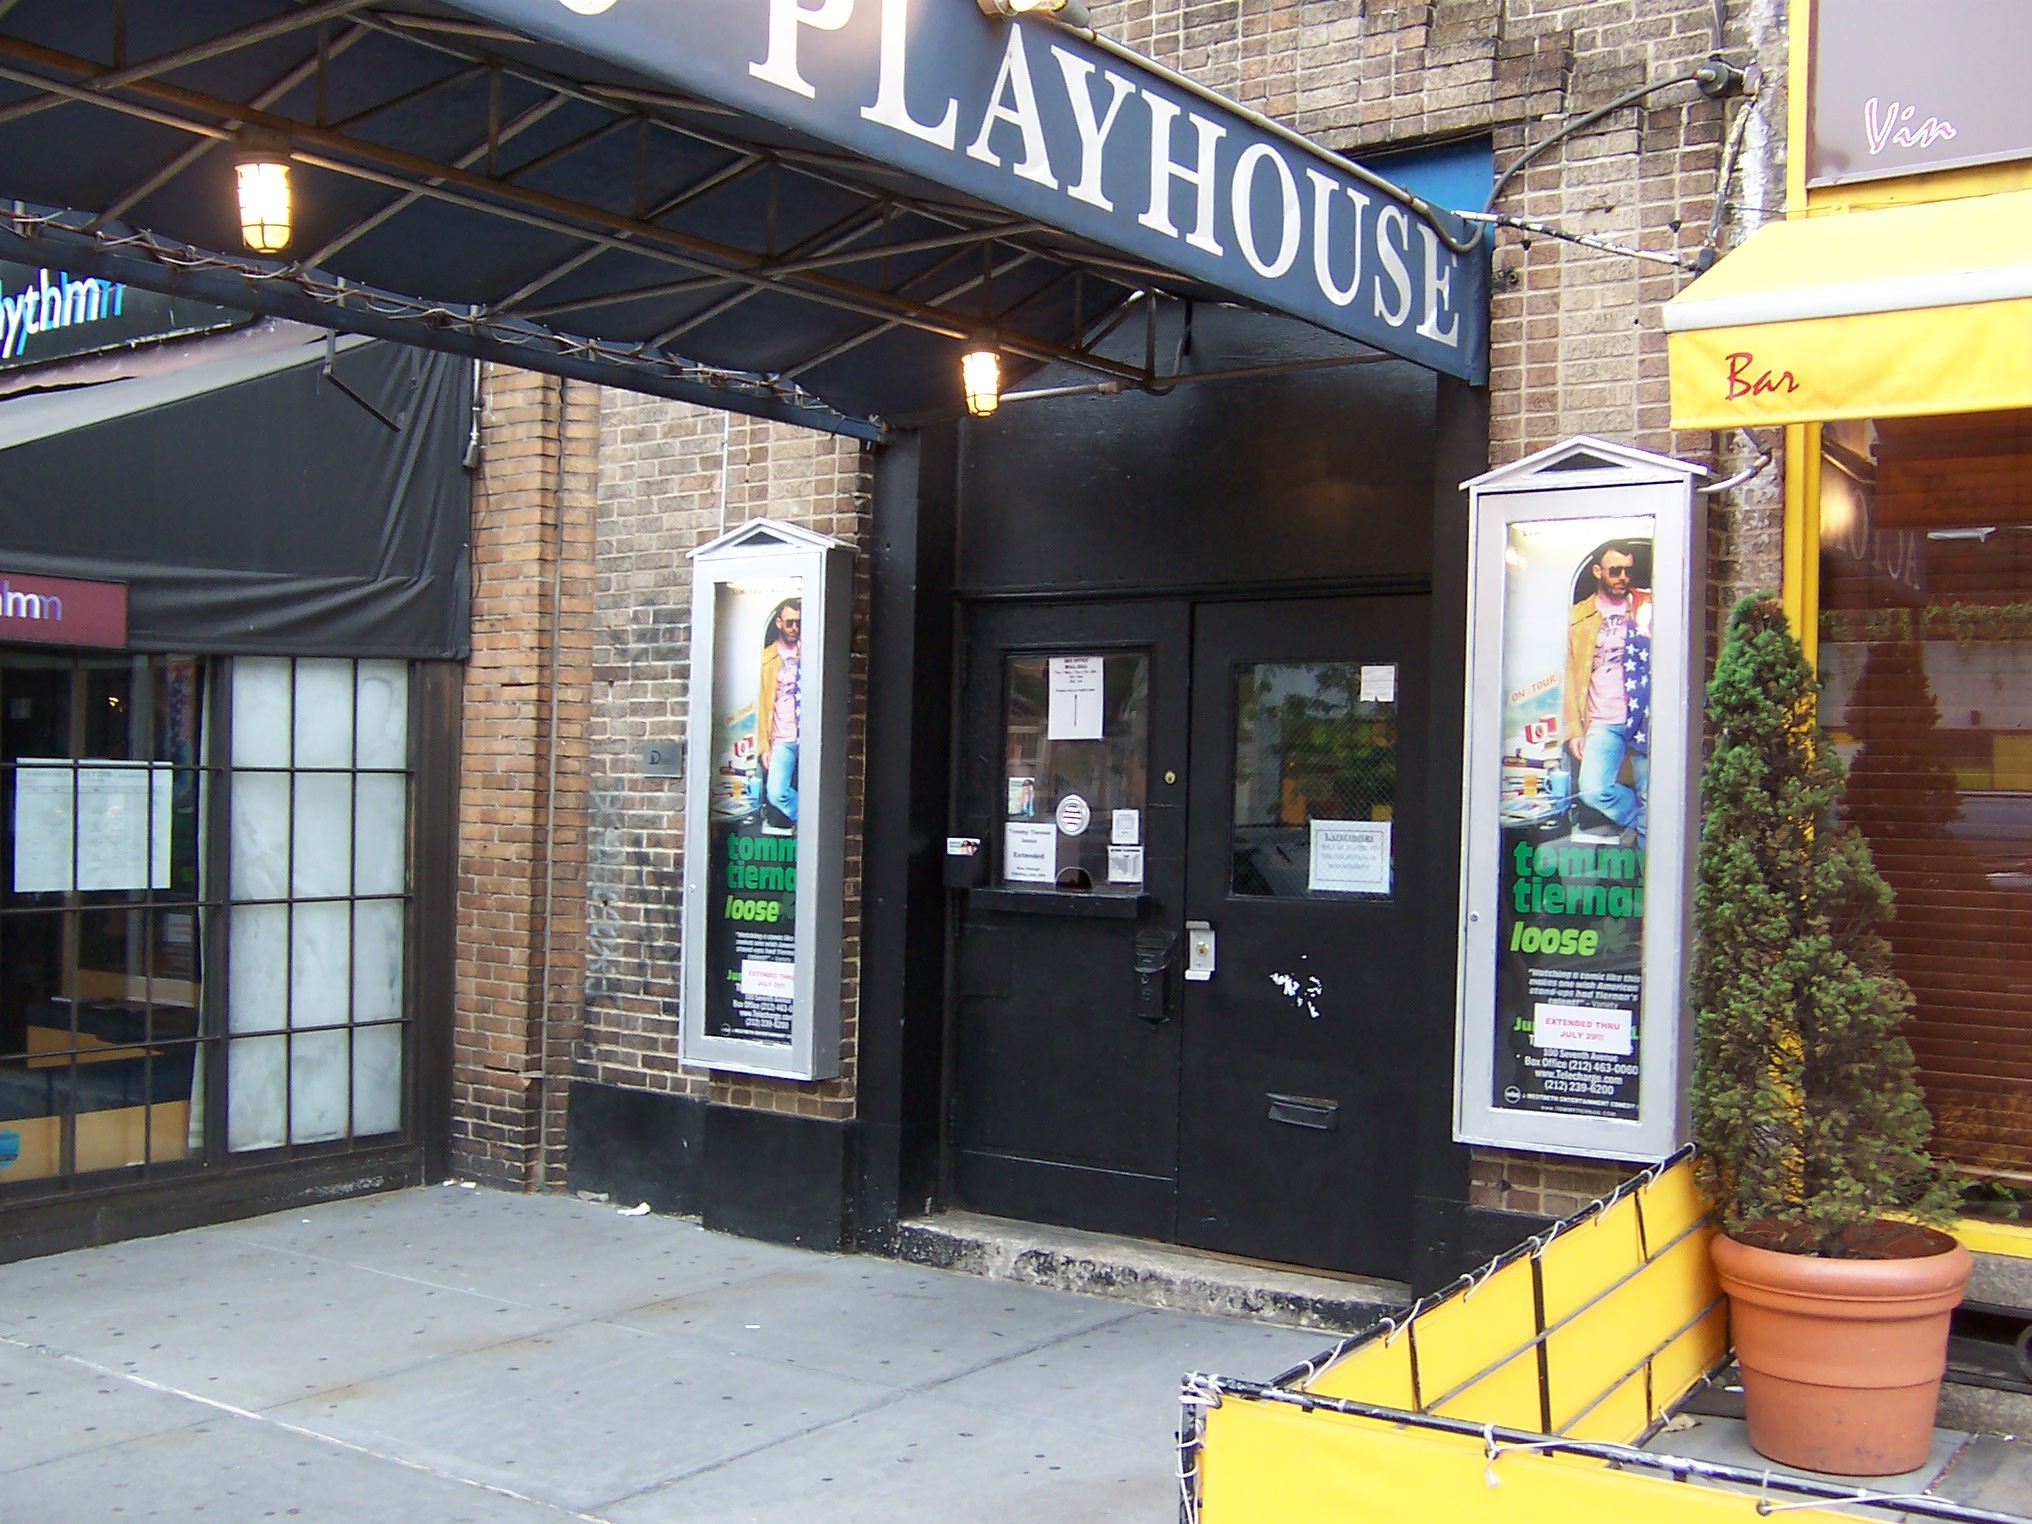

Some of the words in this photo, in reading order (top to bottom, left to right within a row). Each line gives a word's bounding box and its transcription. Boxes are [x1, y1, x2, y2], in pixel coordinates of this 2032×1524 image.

[1865, 97, 1957, 155] Vin
[749, 0, 1460, 348] PLAYHOUSE
[0, 267, 123, 359] ythm
[1725, 352, 1800, 401] Bar
[1531, 674, 1557, 693] TOUR
[724, 894, 780, 923] loose
[1509, 920, 1599, 957] loose
[1513, 1016, 1534, 1032] Ju
[1545, 1017, 1592, 1028] EXTENDED
[1595, 1021, 1621, 1030] THRU
[1560, 1030, 1582, 1039] JULY
[1524, 1056, 1541, 1067] Box
[1541, 1058, 1568, 1069] Office
[1568, 1060, 1592, 1072] (212)
[1544, 1080, 1568, 1092] (212)
